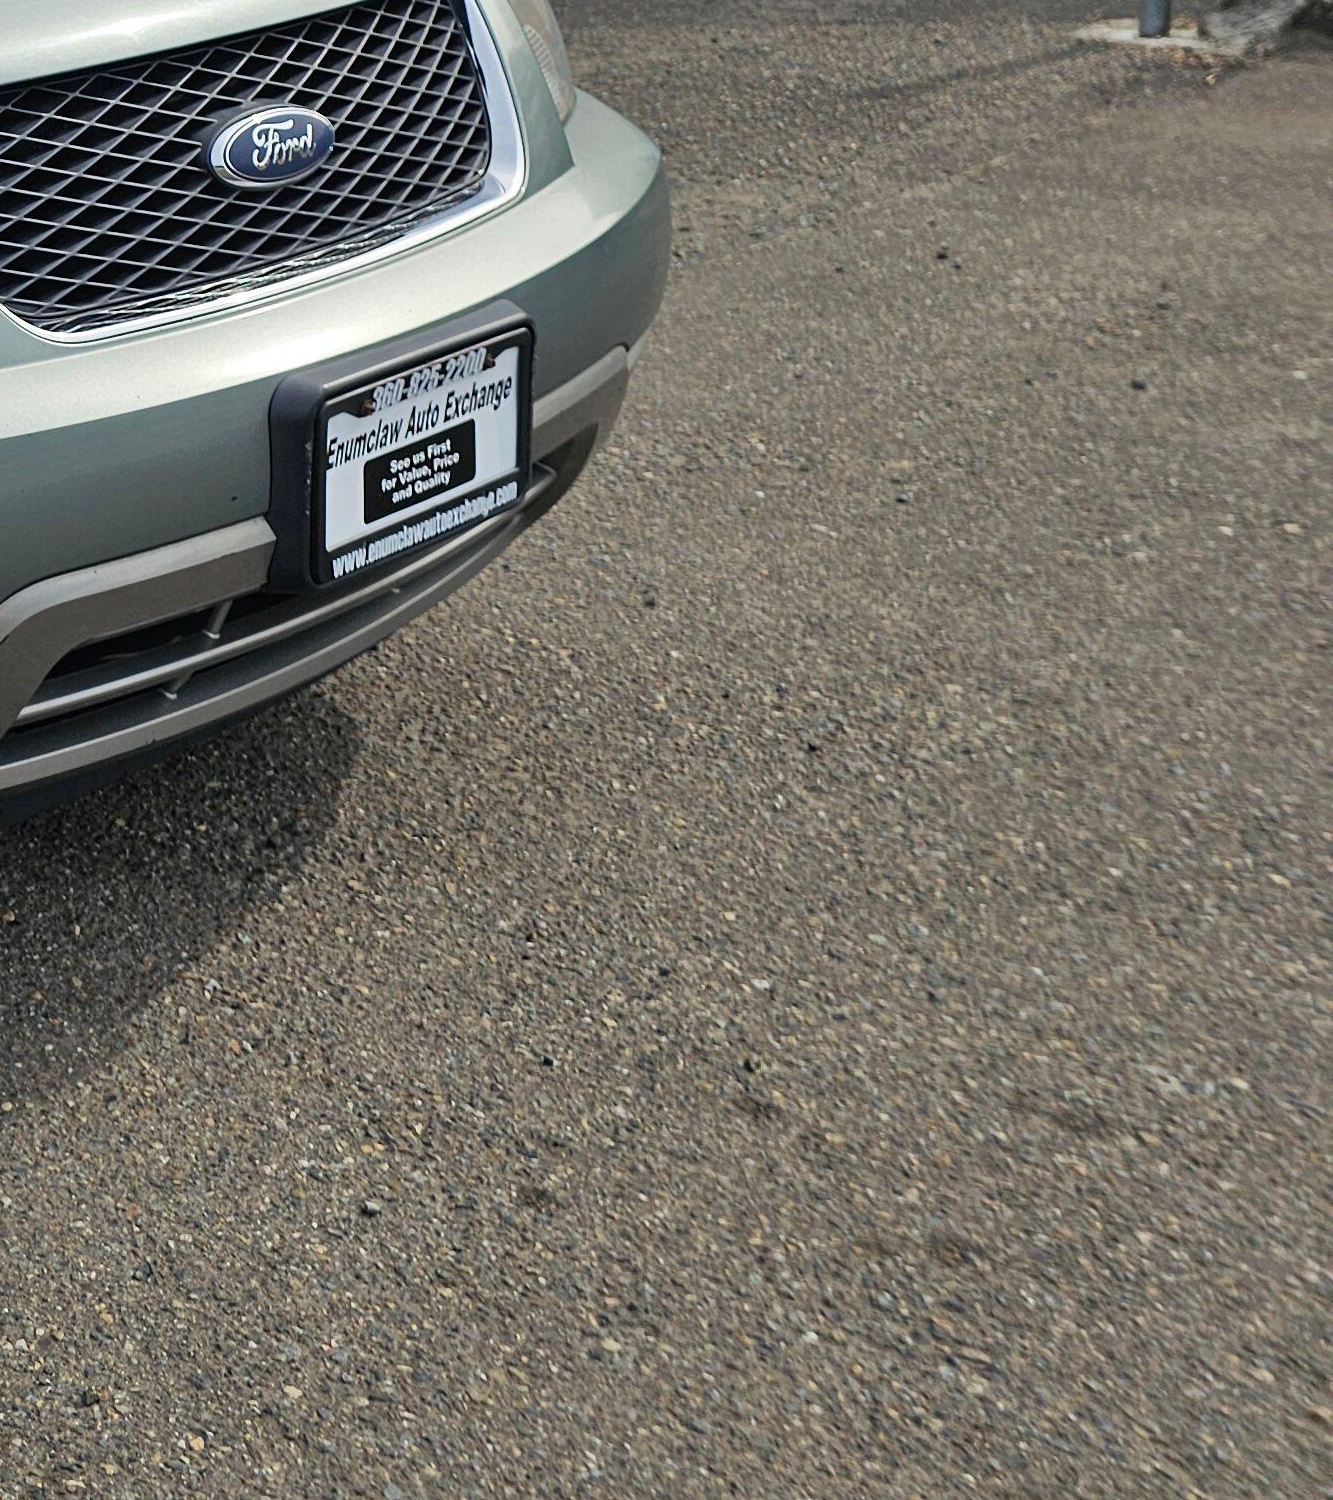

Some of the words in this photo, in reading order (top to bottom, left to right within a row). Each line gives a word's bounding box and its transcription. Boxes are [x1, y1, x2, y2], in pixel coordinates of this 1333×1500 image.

[252, 119, 313, 170] Ford
[370, 347, 487, 413] 360-825-2200
[326, 417, 403, 469] Enumclaw
[405, 402, 440, 439] Auto
[443, 375, 512, 423] Exchange
[381, 476, 398, 493] for
[398, 464, 432, 486] Value,
[433, 452, 460, 472] Price
[389, 457, 411, 475] See
[412, 450, 426, 466] us
[427, 438, 451, 460] First
[392, 486, 413, 504] and
[414, 470, 451, 495] Quality
[333, 480, 518, 578] www.enumclawautoexchange.com
